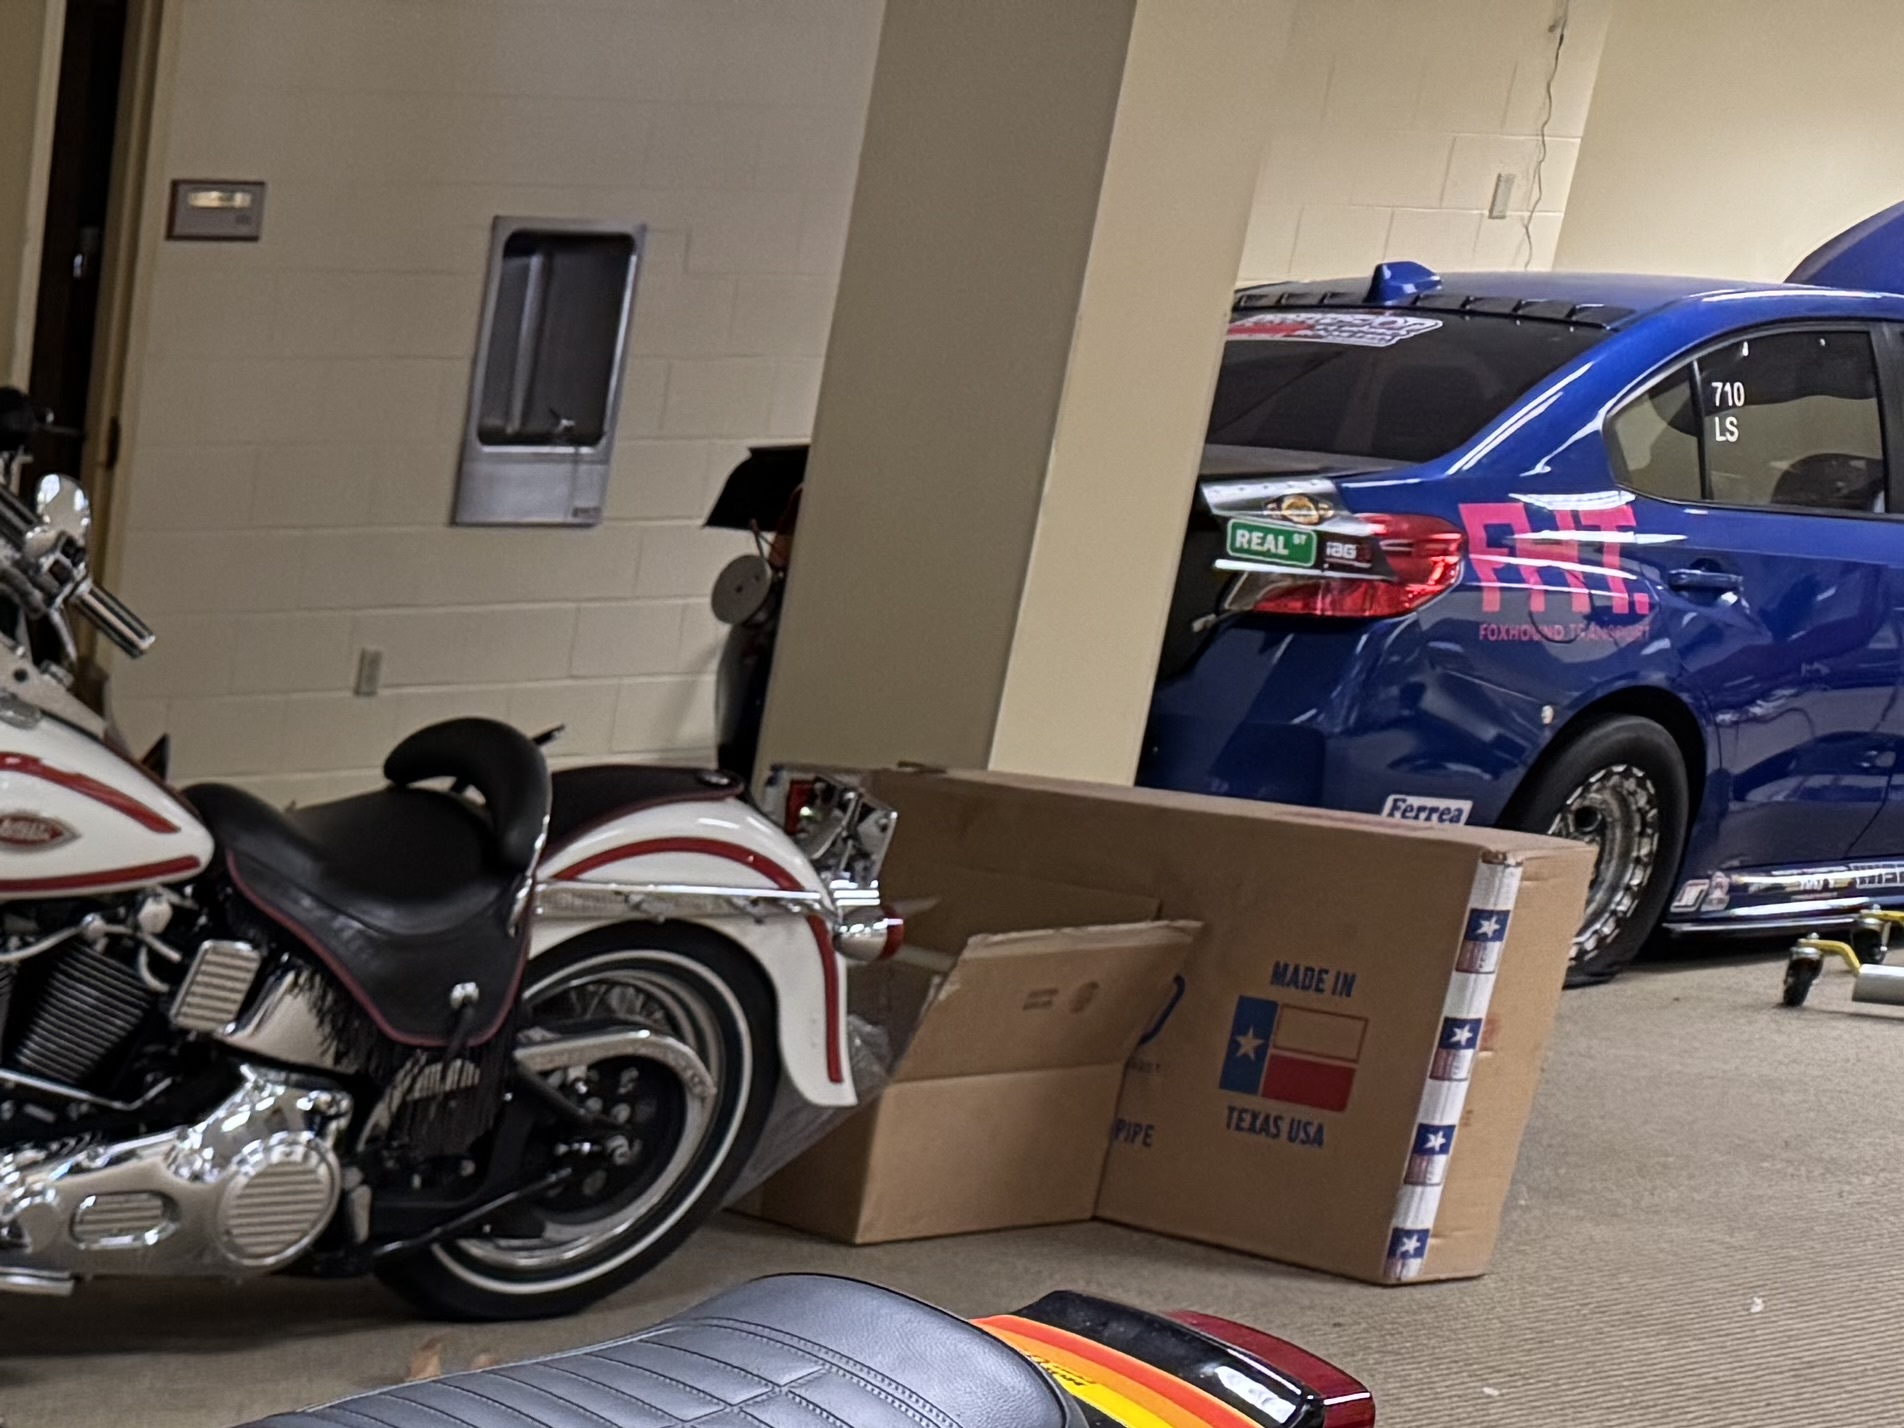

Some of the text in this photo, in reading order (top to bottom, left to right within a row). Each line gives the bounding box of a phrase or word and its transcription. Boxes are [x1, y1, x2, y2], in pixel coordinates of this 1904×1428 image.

[1711, 382, 1745, 407] 710
[1715, 416, 1739, 442] LS
[1235, 529, 1289, 555] REAL
[1387, 798, 1464, 824] Ferrea
[1269, 960, 1357, 998] MADE IN
[1225, 1105, 1325, 1149] TEXAS USA
